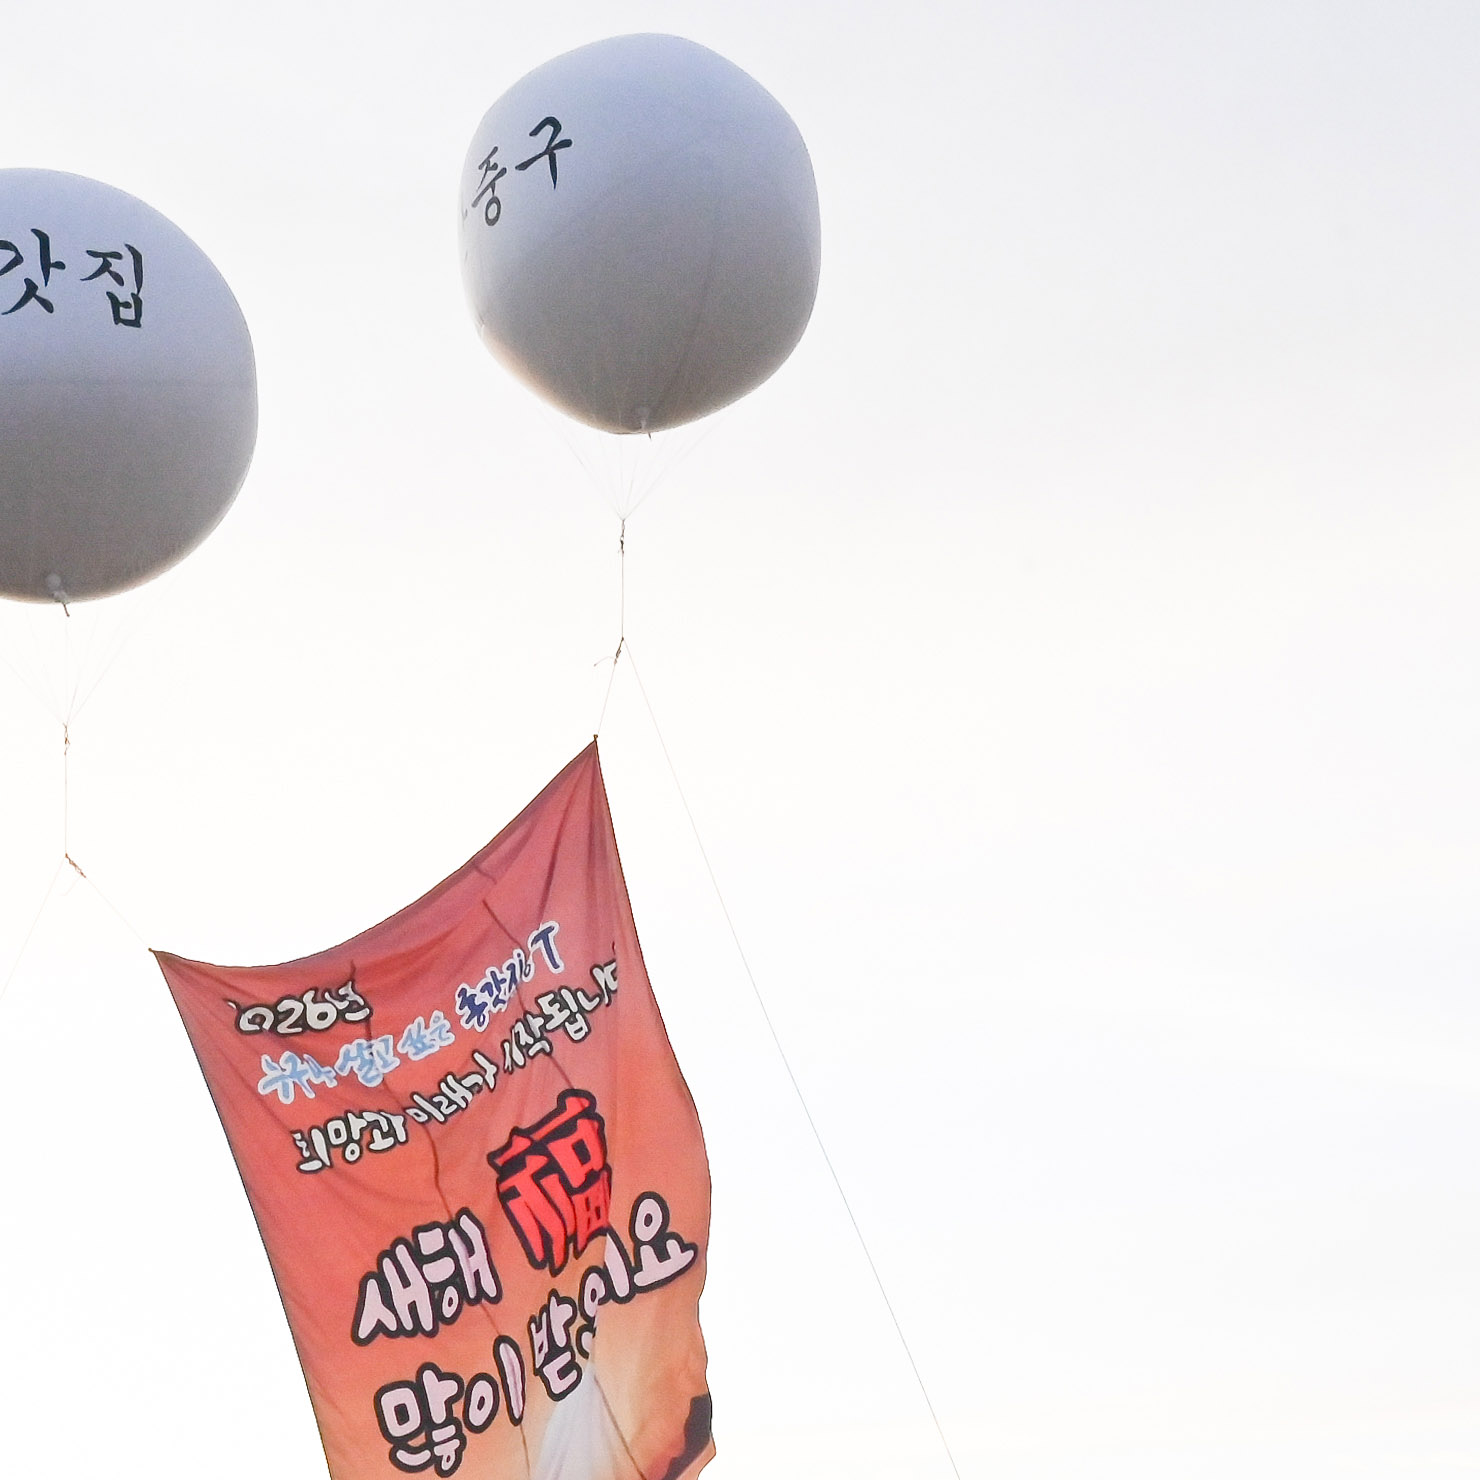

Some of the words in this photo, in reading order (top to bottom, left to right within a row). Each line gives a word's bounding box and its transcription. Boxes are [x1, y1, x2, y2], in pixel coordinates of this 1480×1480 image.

[471, 115, 573, 227] 중구
[351, 1206, 503, 1347] 새해
[487, 1088, 613, 1278] 福
[373, 1335, 526, 1478] 많이
